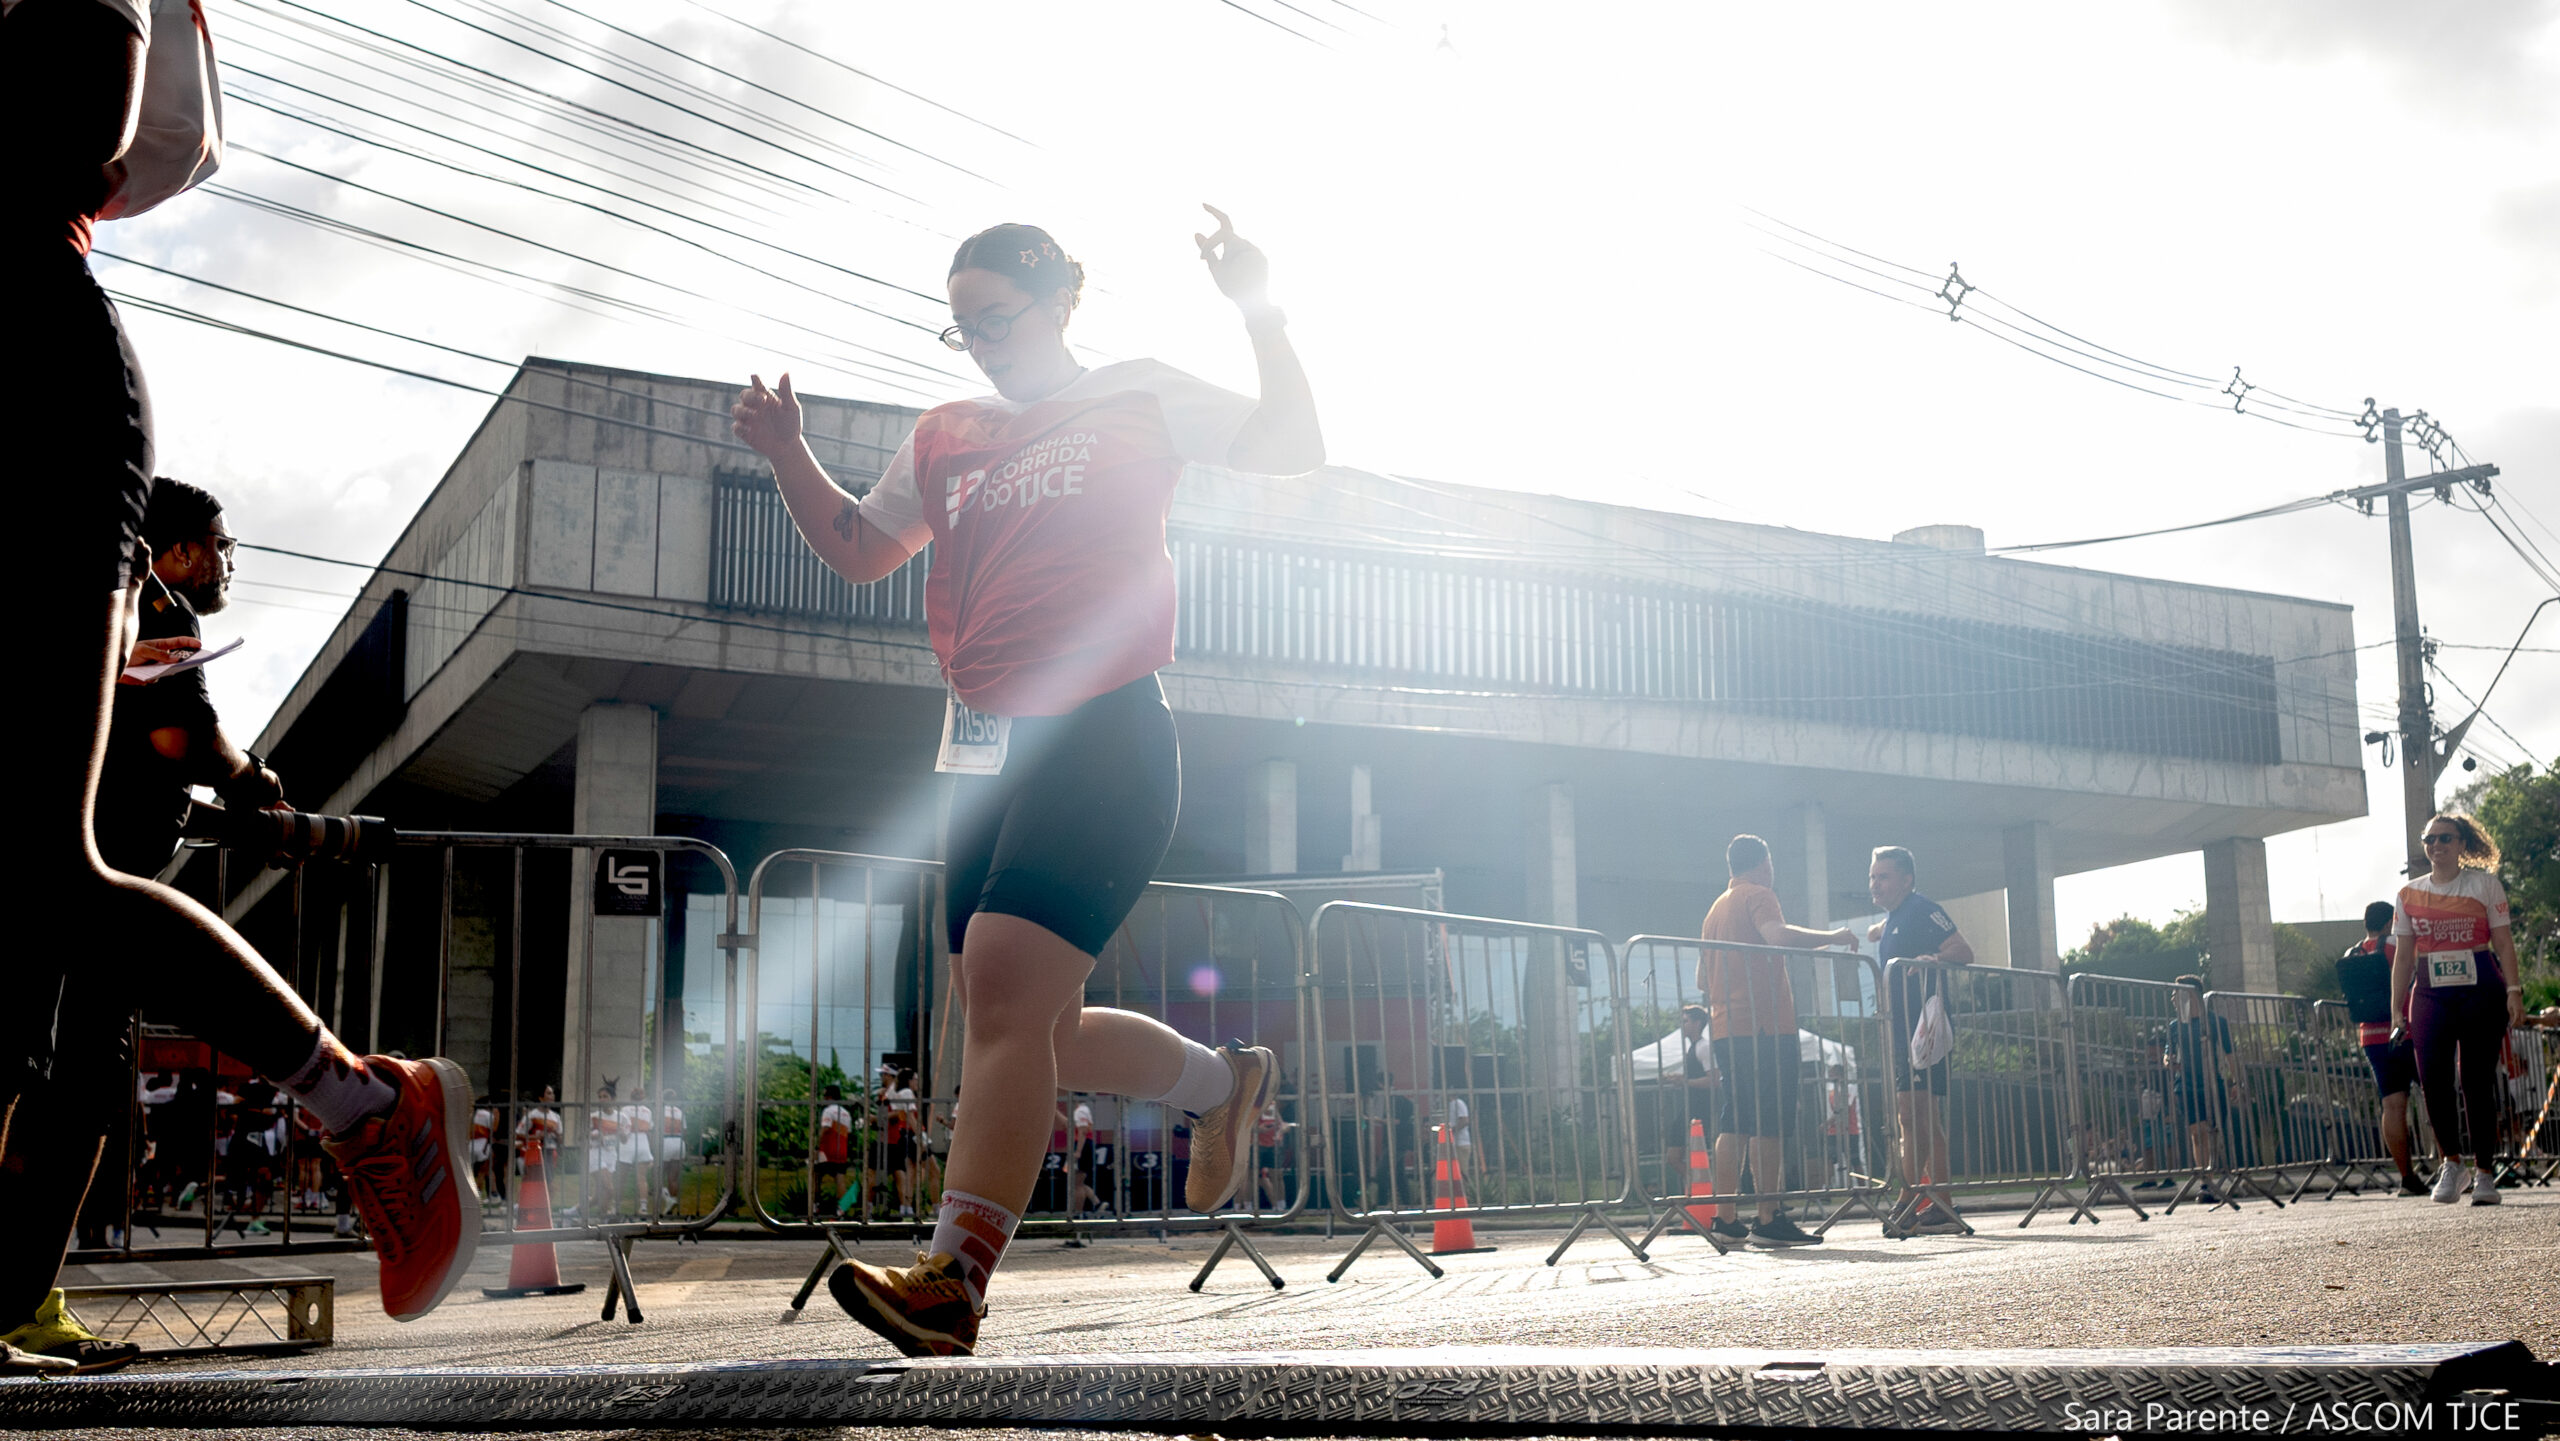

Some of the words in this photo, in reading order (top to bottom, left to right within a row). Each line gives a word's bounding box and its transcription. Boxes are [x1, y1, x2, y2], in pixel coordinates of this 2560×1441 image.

[983, 482, 1012, 512] DO
[1015, 464, 1085, 508] TJCE
[2448, 929, 2474, 943] TJCE
[2438, 961, 2463, 975] 182
[1045, 1154, 1061, 1169] 2
[1141, 1153, 1158, 1169] 3
